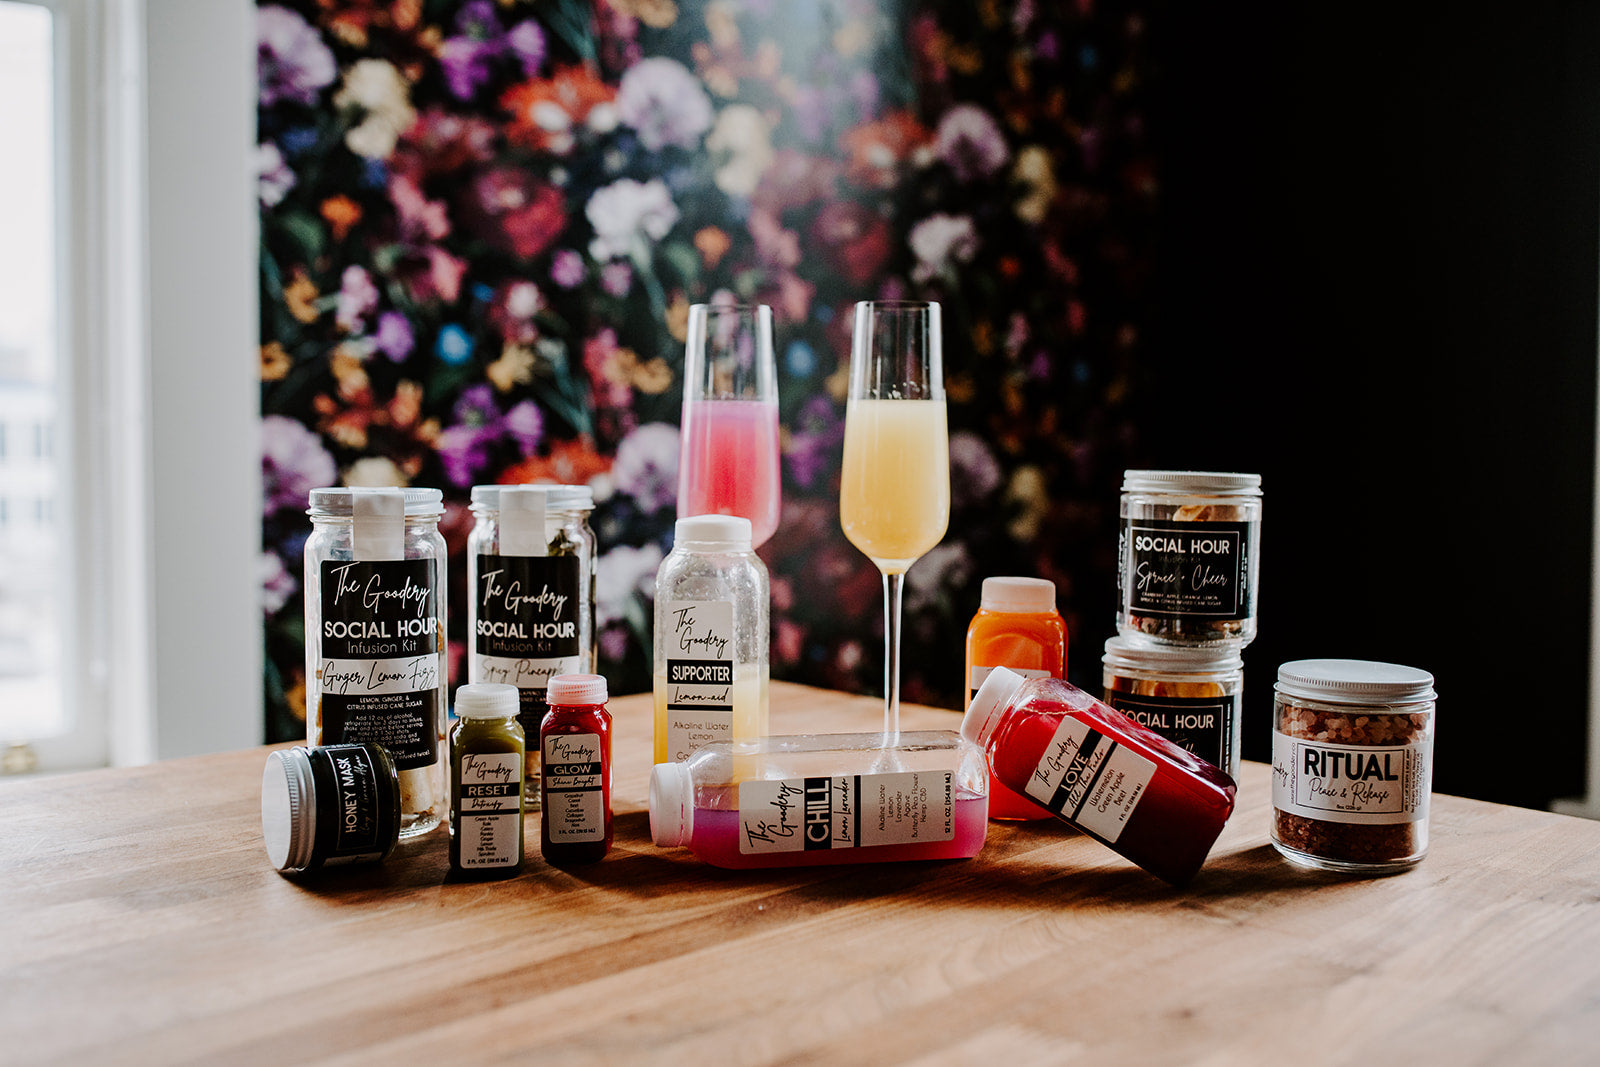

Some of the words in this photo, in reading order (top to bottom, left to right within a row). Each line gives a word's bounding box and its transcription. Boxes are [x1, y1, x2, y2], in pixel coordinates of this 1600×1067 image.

[1135, 535, 1186, 553] SOCIAL
[1191, 539, 1230, 554] HOUR
[331, 561, 360, 606] The
[363, 574, 431, 618] Goodery
[1136, 561, 1176, 592] Spruce
[1191, 564, 1228, 591] Cheer
[481, 569, 504, 606] The
[504, 580, 568, 621] Goodery
[324, 621, 391, 639] SOCIAL
[397, 617, 438, 638] HOUR
[477, 619, 528, 639] SOCIAL
[533, 622, 576, 639] HOUR
[673, 606, 696, 633] The
[348, 641, 398, 654] Infusion
[402, 639, 417, 652] Kit
[492, 639, 533, 652] Infusion
[537, 639, 552, 651] Kit
[680, 626, 729, 659] Goodery
[322, 661, 364, 695] Ginger
[367, 661, 406, 690] Lemon
[672, 665, 730, 682] SUPPORTER
[405, 700, 423, 708] SUGAR
[674, 686, 729, 703] Lemon-aid
[673, 721, 703, 730] Alkaline
[705, 722, 729, 730] Water
[1175, 715, 1214, 729] HOUR
[549, 736, 563, 755] The
[562, 743, 595, 761] Goodery
[688, 732, 714, 740] Lemon
[336, 757, 355, 787] MASK
[464, 755, 479, 775] The
[477, 761, 514, 783] Goodery
[554, 764, 592, 775] GLOW
[1034, 766, 1051, 787] The
[1046, 736, 1079, 772] Goodery
[1061, 753, 1089, 792] LOVE
[1304, 748, 1399, 781] RITUAL
[468, 785, 510, 796] RESET
[552, 777, 572, 786] Shine
[573, 776, 596, 787] Bright
[1069, 789, 1082, 809] All
[1078, 772, 1091, 790] The
[1089, 769, 1115, 807] Watermelon
[1097, 793, 1112, 813] Green
[1111, 772, 1125, 794] Apple
[1308, 777, 1338, 801] Peace
[1340, 788, 1347, 798] &
[1351, 781, 1389, 805] Release
[767, 782, 803, 837] Goodery
[833, 778, 852, 815] Lavender
[1113, 790, 1127, 806] Beet
[344, 791, 357, 833] HONEY
[807, 780, 830, 842] CHILL
[745, 820, 775, 848] The
[833, 815, 852, 842] Lemon
[911, 812, 919, 838] Butterfly
